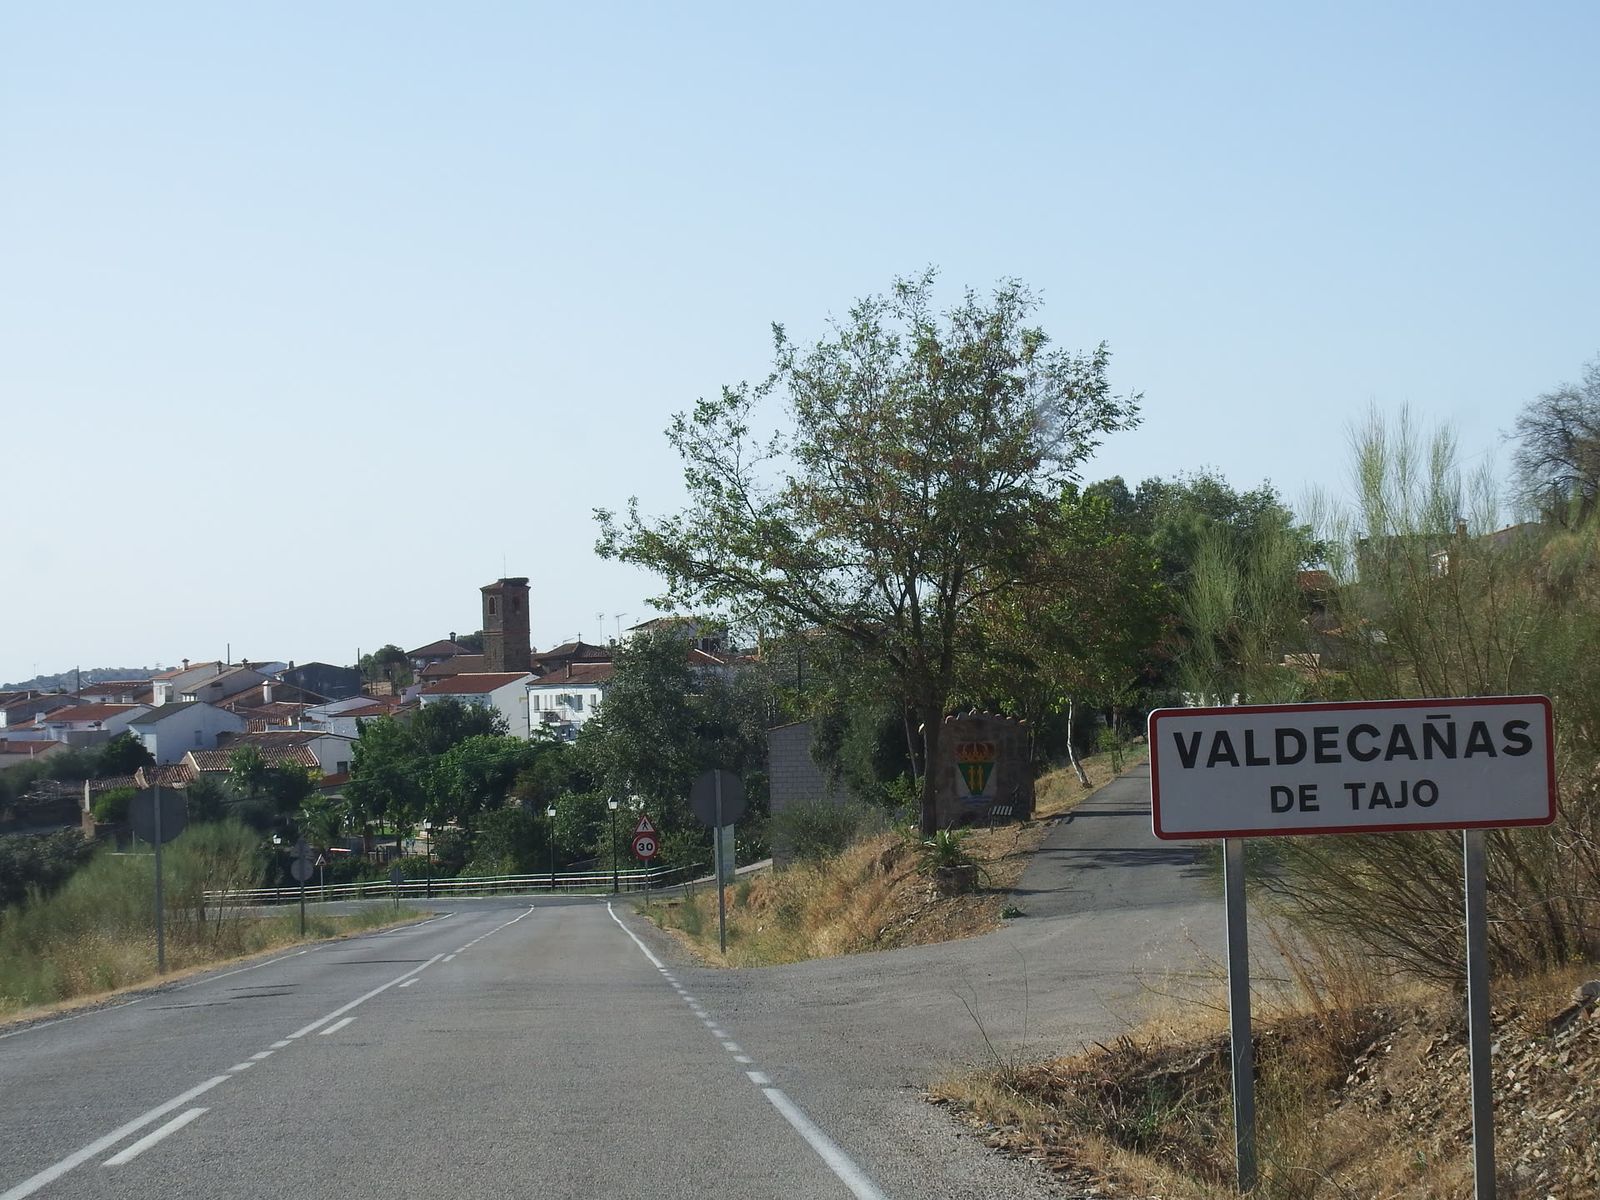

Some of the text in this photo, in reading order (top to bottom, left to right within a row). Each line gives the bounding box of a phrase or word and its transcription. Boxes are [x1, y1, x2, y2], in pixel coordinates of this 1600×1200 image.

[1173, 714, 1533, 769] VALDECAÑAS
[1271, 779, 1439, 813] DE TAJO
[638, 842, 653, 851] 30
